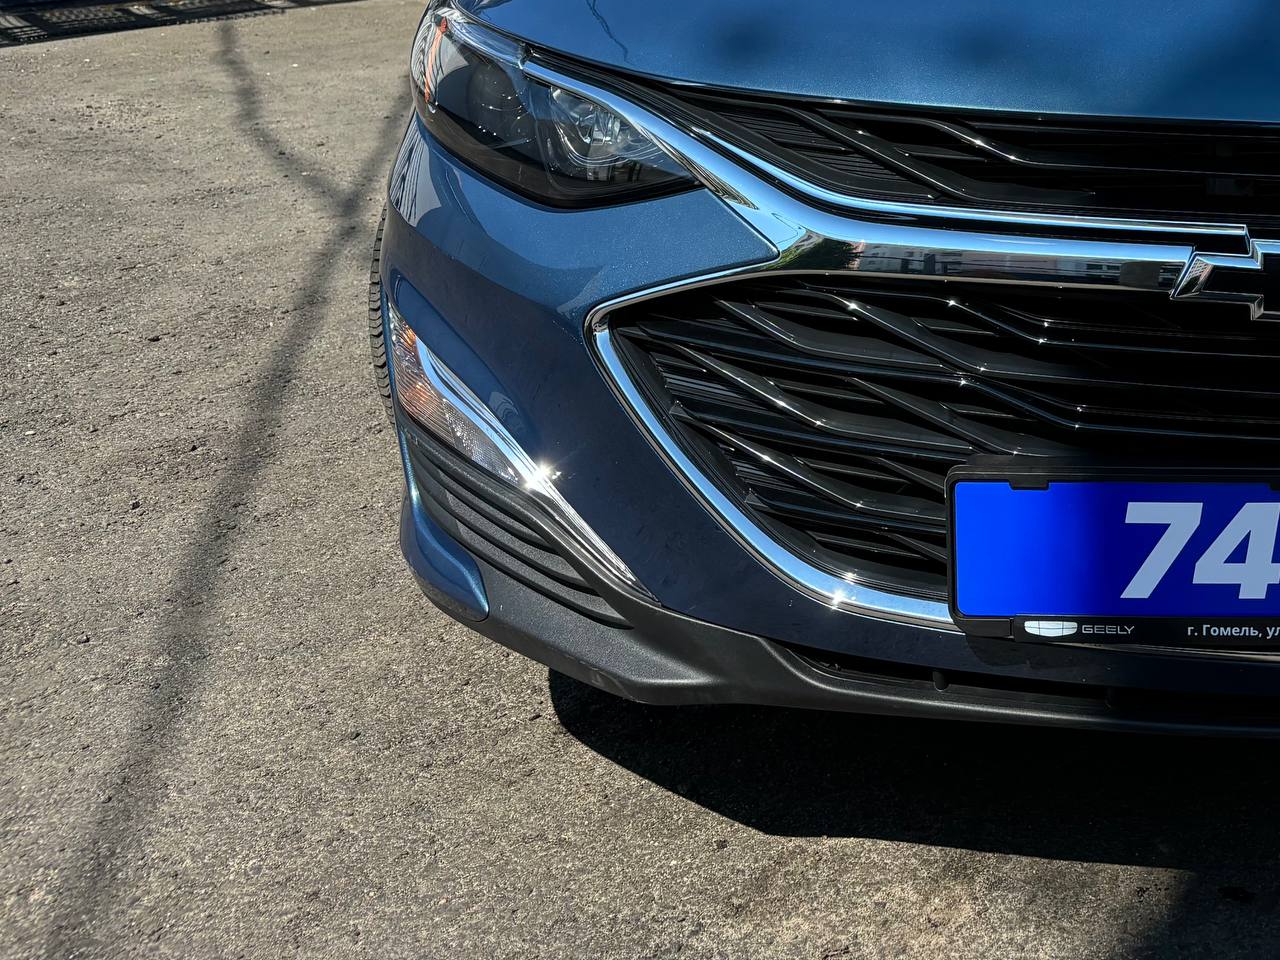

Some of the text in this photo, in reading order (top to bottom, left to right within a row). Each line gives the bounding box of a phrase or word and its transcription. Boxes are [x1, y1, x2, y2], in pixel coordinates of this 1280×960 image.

[1082, 625, 1135, 634] GEELY
[1187, 626, 1198, 636] г.
[1202, 625, 1263, 639] Гомель,
